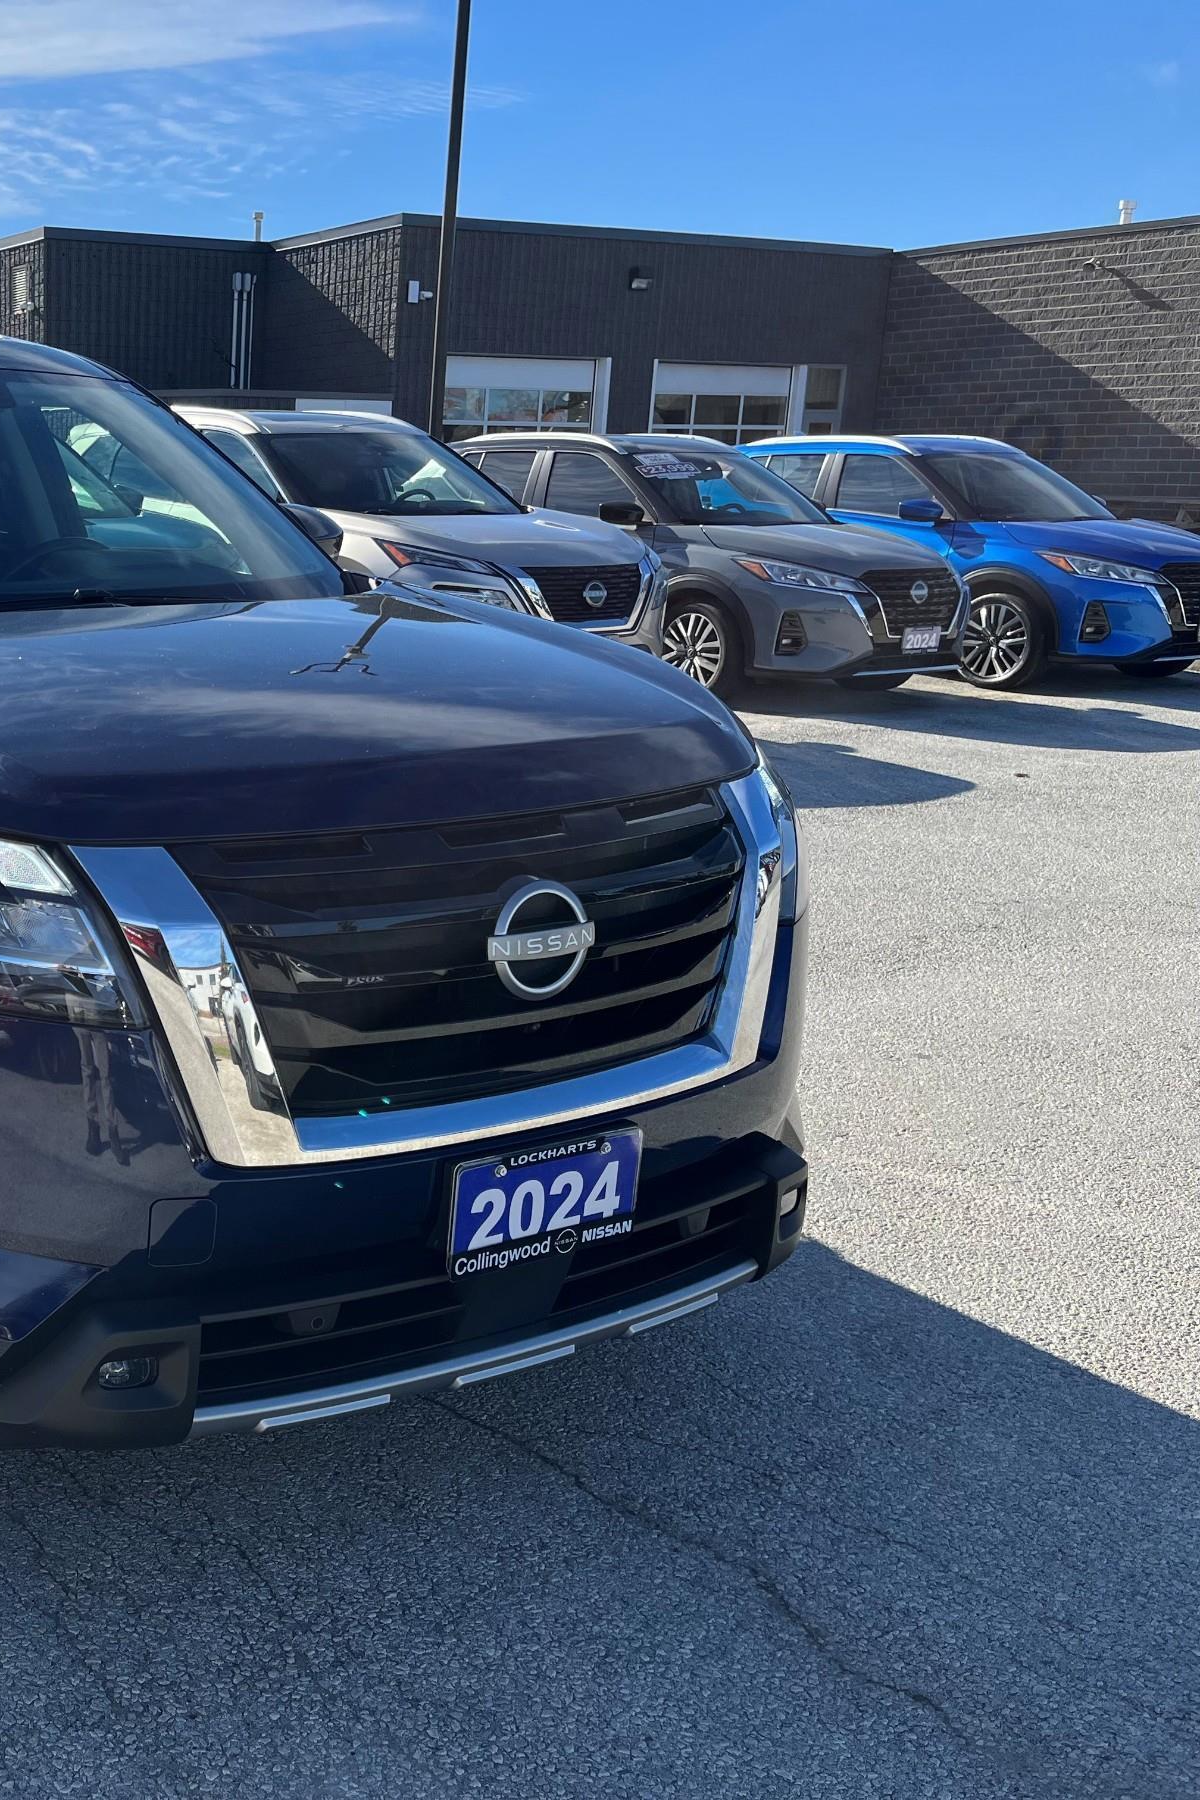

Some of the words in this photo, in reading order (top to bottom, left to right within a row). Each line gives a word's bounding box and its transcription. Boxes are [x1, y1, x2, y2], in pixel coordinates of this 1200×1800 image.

[905, 633, 937, 649] 2024
[492, 928, 593, 957] NISSAN
[510, 1140, 597, 1167] LOCKHARTS
[467, 1160, 621, 1251] 2024
[454, 1237, 550, 1276] Collingwood
[581, 1220, 633, 1243] NISSAN
